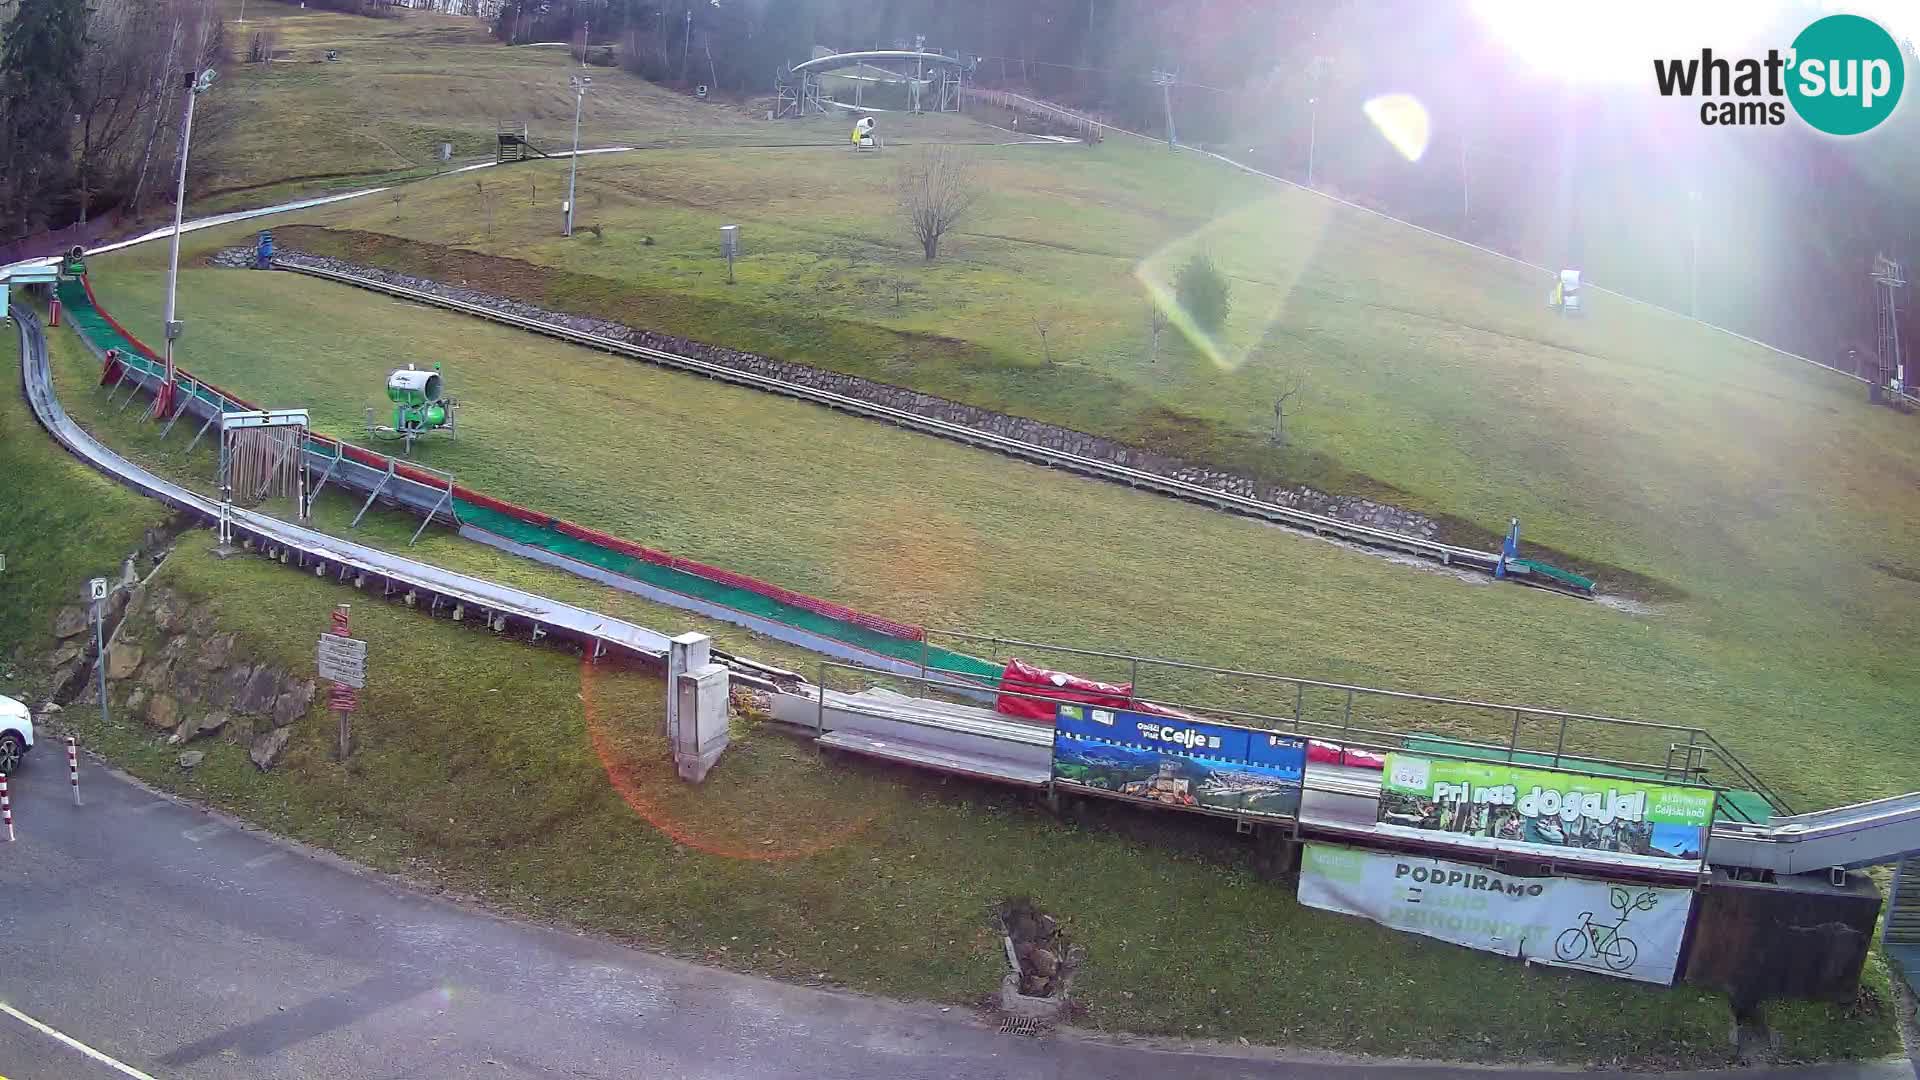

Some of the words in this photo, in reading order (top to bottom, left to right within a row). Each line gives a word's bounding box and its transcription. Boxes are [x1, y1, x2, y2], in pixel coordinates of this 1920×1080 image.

[1160, 726, 1206, 749] Celje
[1473, 784, 1517, 805] nas
[1395, 863, 1544, 897] PODPIRAMO
